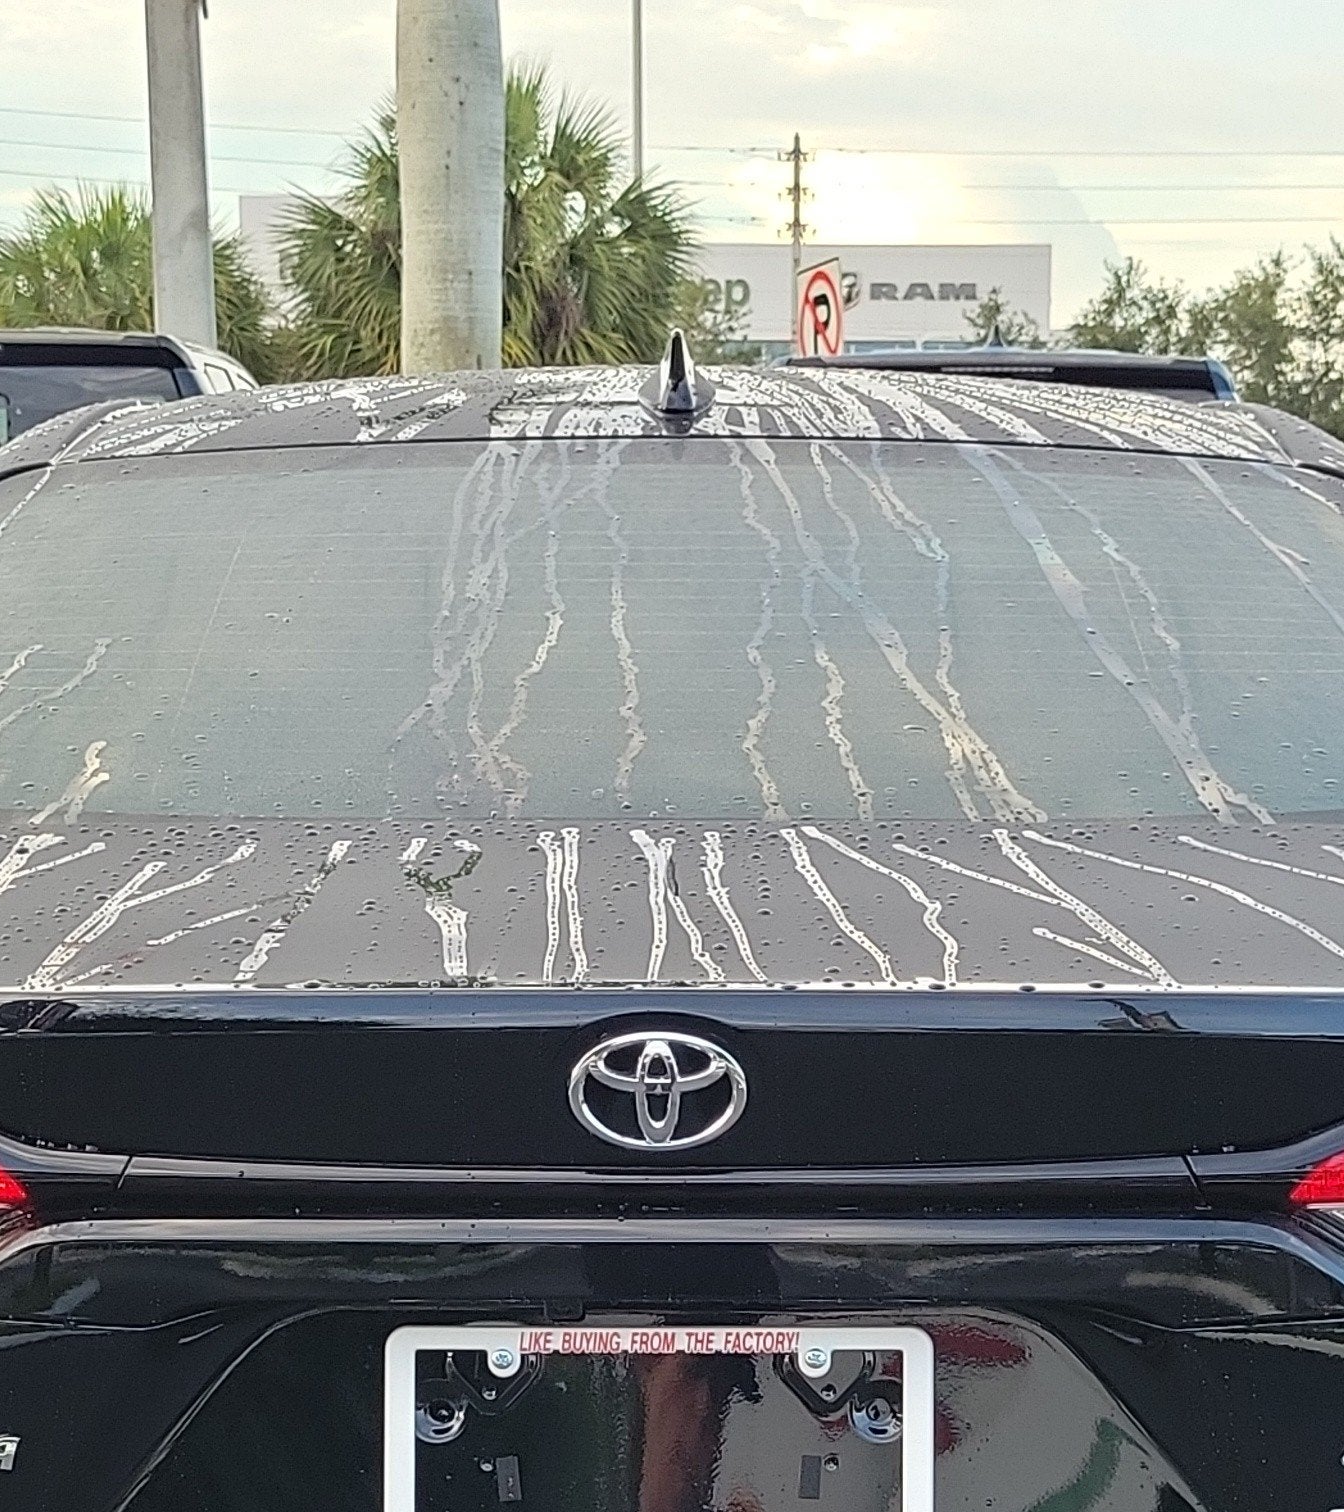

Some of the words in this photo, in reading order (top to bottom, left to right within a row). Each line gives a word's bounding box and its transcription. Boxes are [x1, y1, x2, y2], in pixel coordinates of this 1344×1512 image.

[869, 282, 977, 301] RAM
[519, 1332, 553, 1352] LIKE
[561, 1332, 621, 1352] BUYING
[630, 1332, 676, 1352] FROM
[684, 1332, 715, 1351] THE
[723, 1332, 800, 1352] FACTORY!
